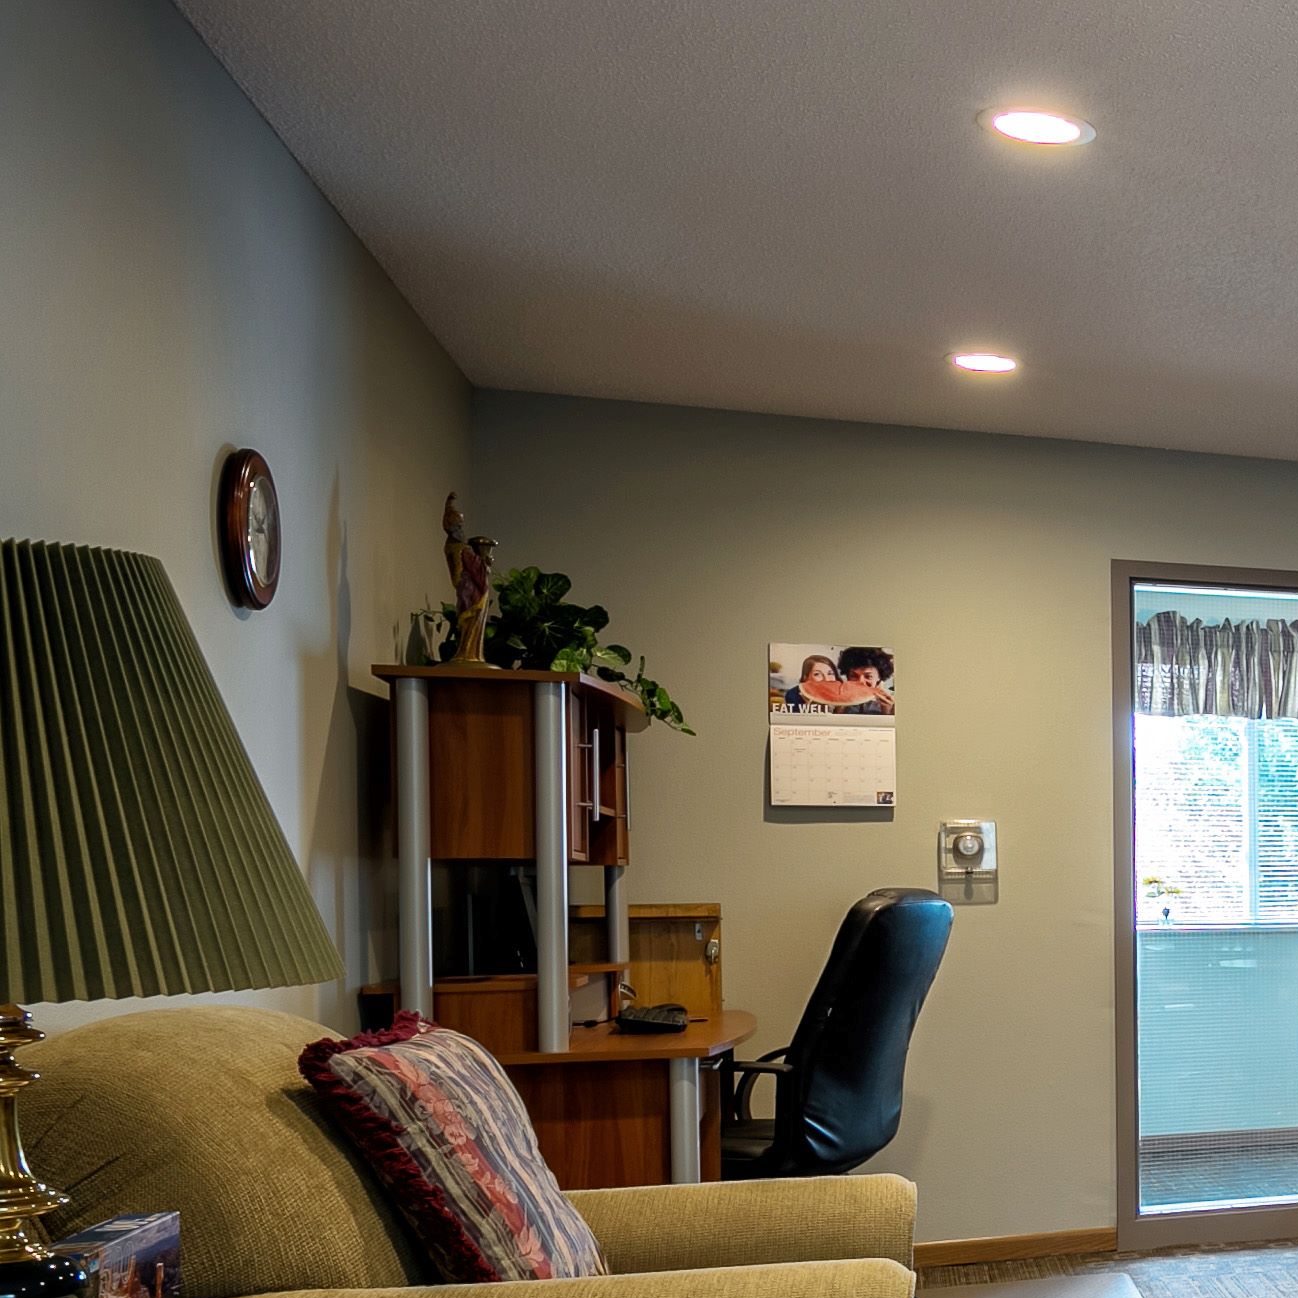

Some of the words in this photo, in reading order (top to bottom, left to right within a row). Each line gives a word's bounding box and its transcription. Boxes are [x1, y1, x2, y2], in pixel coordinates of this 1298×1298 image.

[772, 703, 795, 714] EAT
[798, 703, 832, 714] WELL
[773, 727, 831, 738] September
